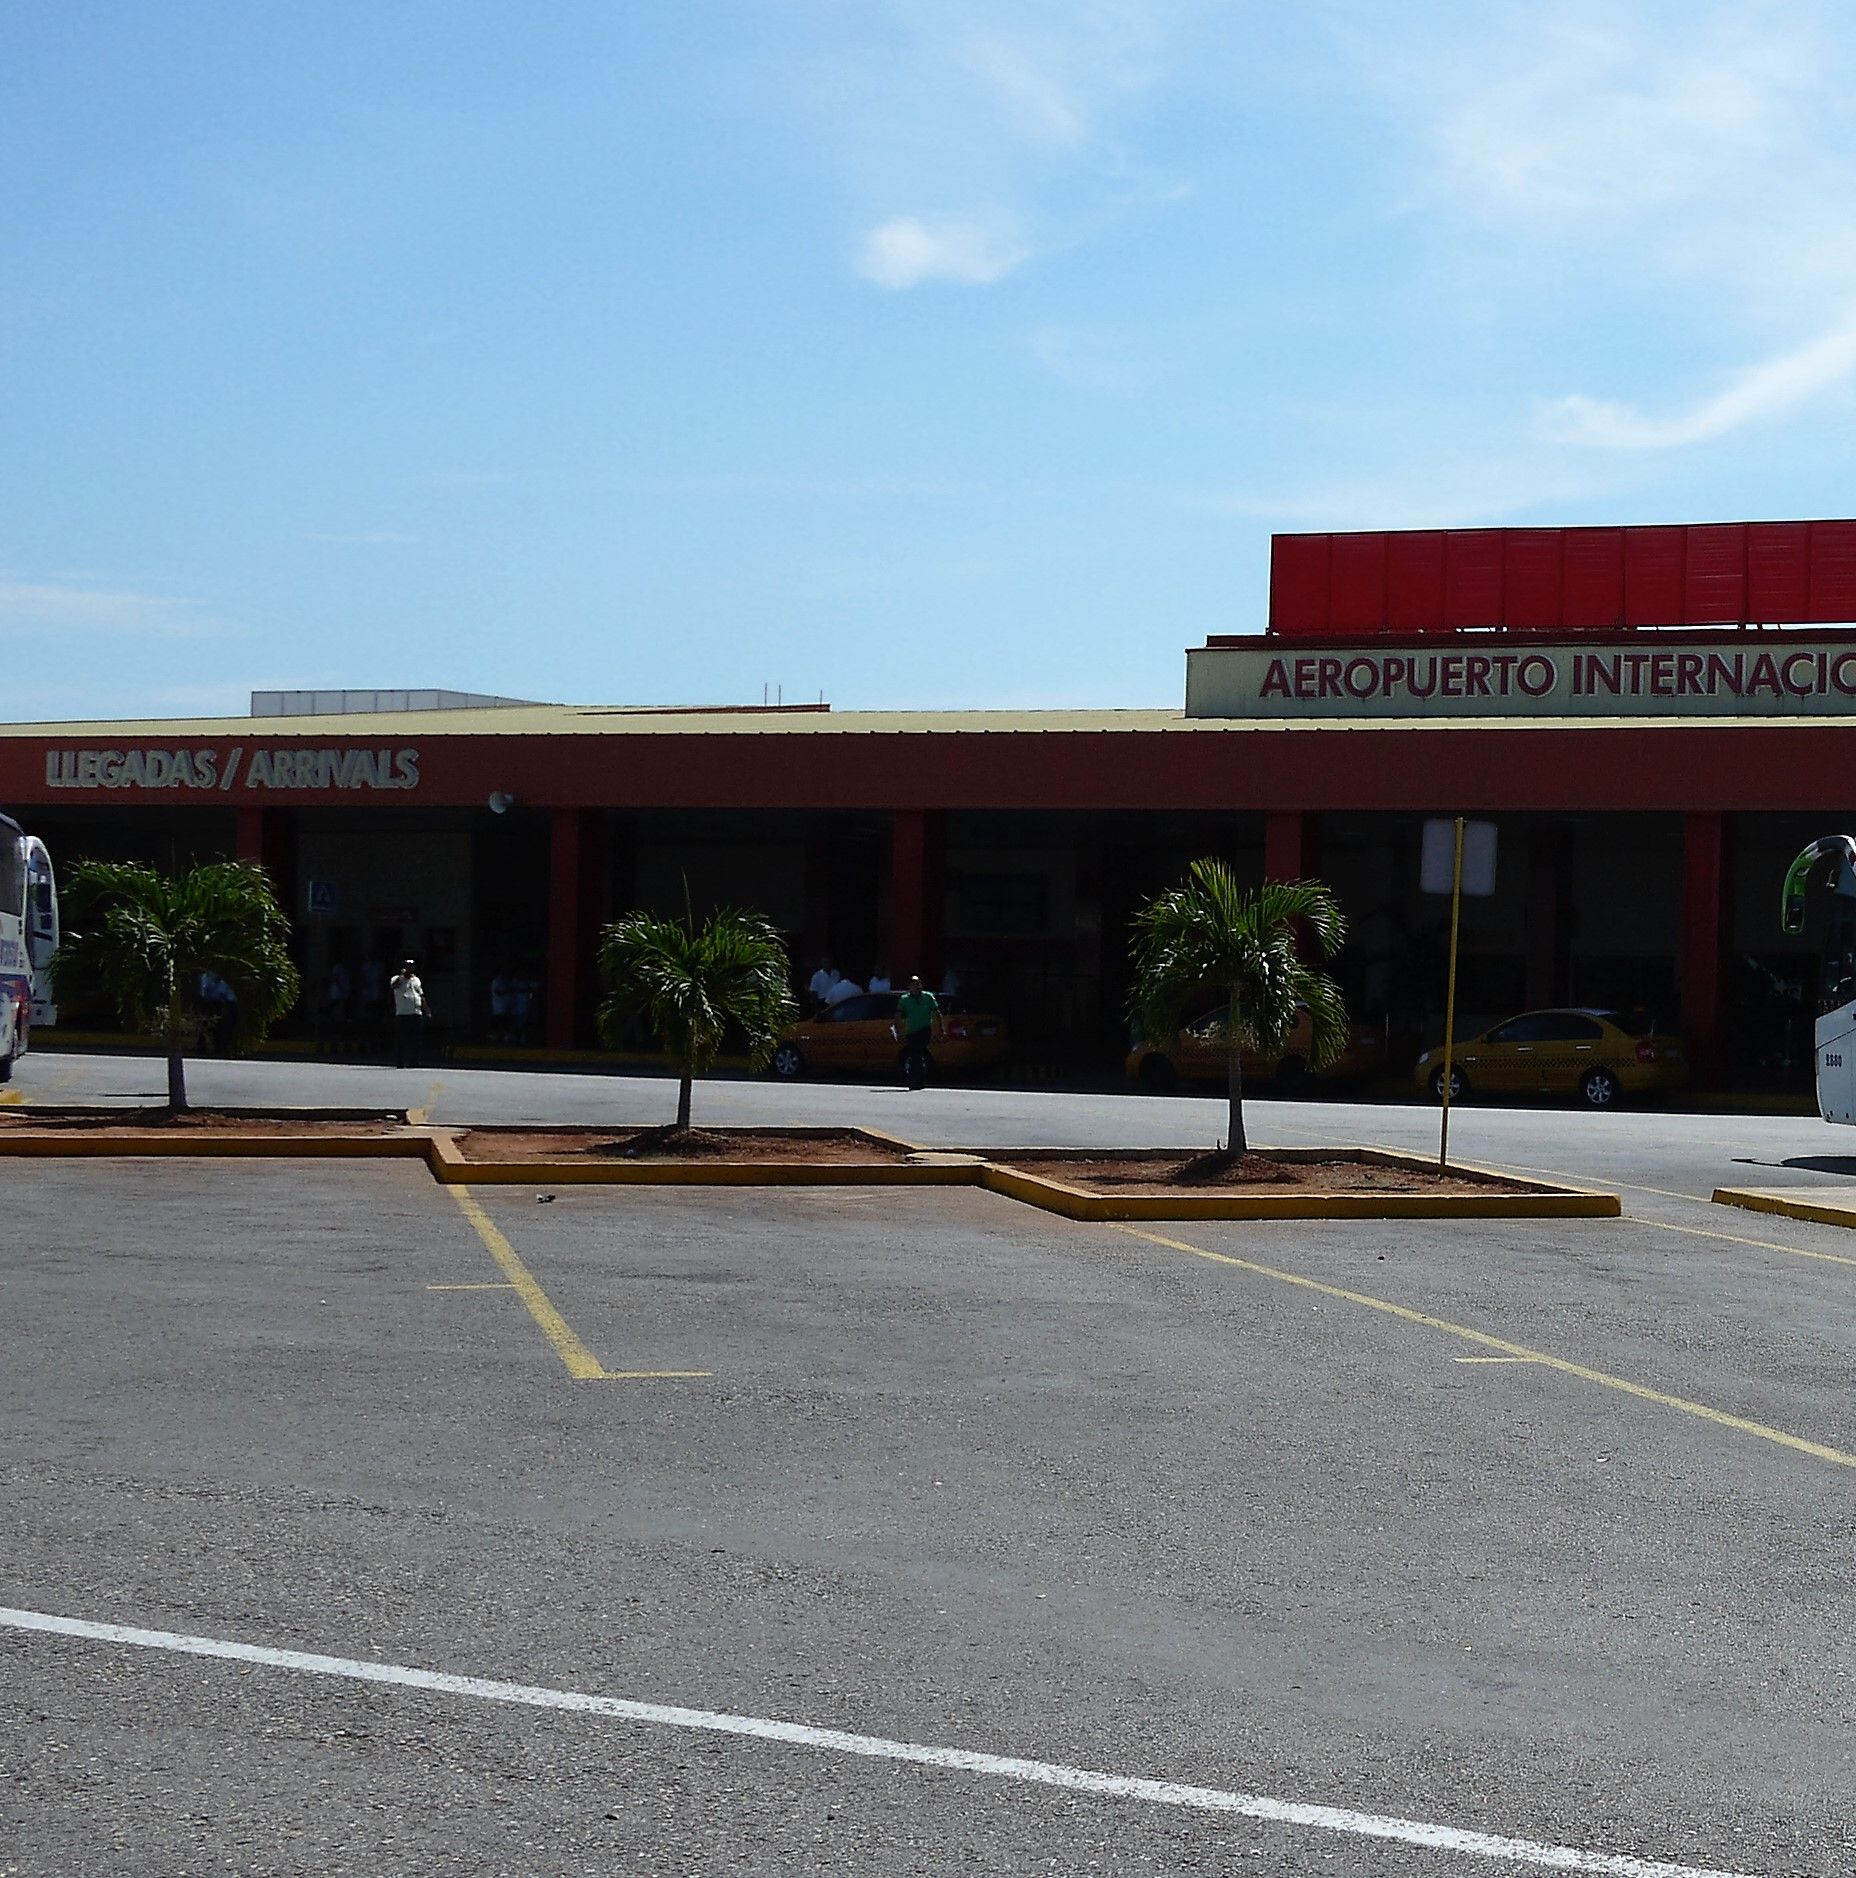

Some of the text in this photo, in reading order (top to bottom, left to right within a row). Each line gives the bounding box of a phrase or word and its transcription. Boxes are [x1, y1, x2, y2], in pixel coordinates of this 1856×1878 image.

[1258, 654, 1557, 700] AEROPUERTO
[46, 747, 421, 791] LLEGADAS / ARRIVALS
